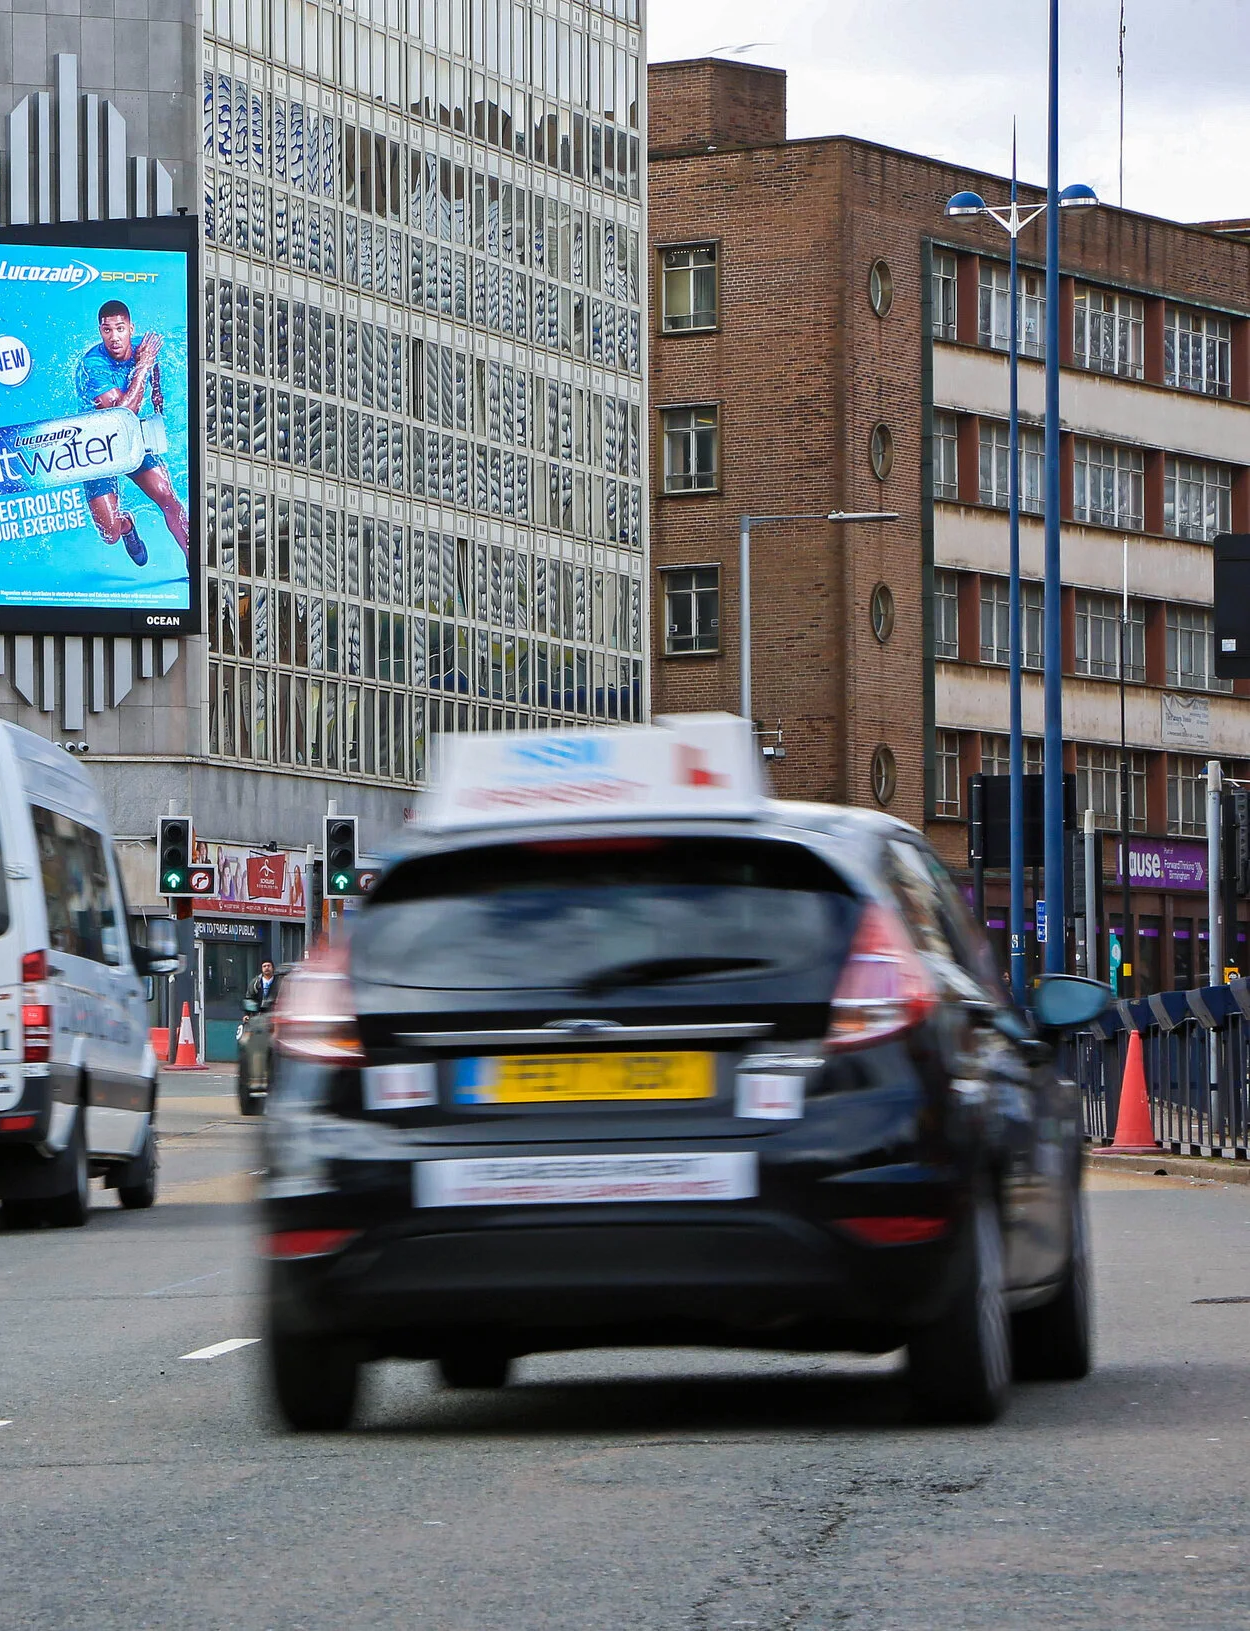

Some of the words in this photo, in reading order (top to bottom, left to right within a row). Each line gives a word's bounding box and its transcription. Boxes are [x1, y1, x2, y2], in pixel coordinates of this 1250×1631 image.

[100, 271, 159, 284] SPORT
[15, 428, 71, 447] Lucozade
[23, 510, 86, 537] EXERCISE
[147, 616, 180, 626] OCEAN
[228, 924, 239, 935] AND
